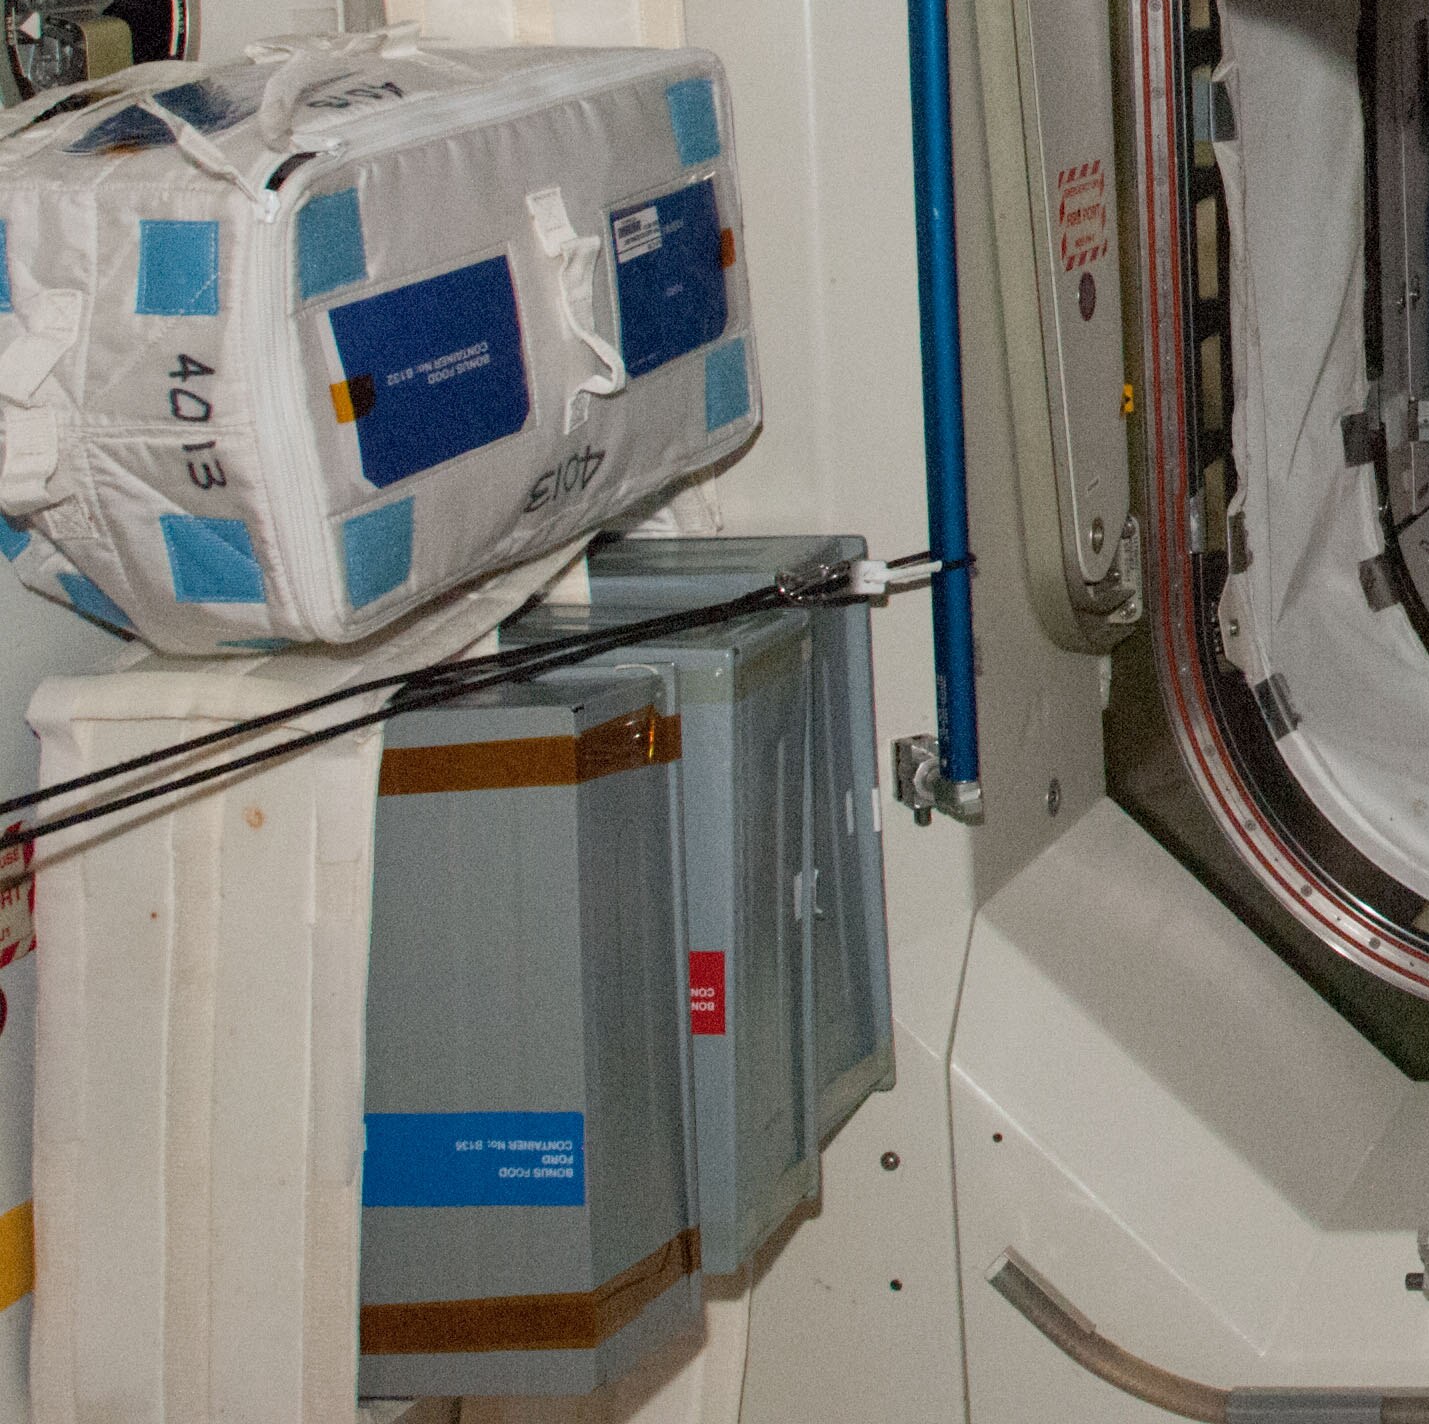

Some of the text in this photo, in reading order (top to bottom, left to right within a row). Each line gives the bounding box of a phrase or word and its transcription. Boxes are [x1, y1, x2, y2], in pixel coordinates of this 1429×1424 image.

[434, 339, 490, 375] CONTAINER
[425, 352, 491, 385] BONUS FOOD
[167, 353, 228, 492] 4013
[523, 444, 605, 513] 4013
[487, 1140, 507, 1151] No:
[509, 1140, 574, 1151] CONTAINER
[541, 1154, 574, 1165] FORD
[498, 1167, 574, 1178] BONUS FOOD
